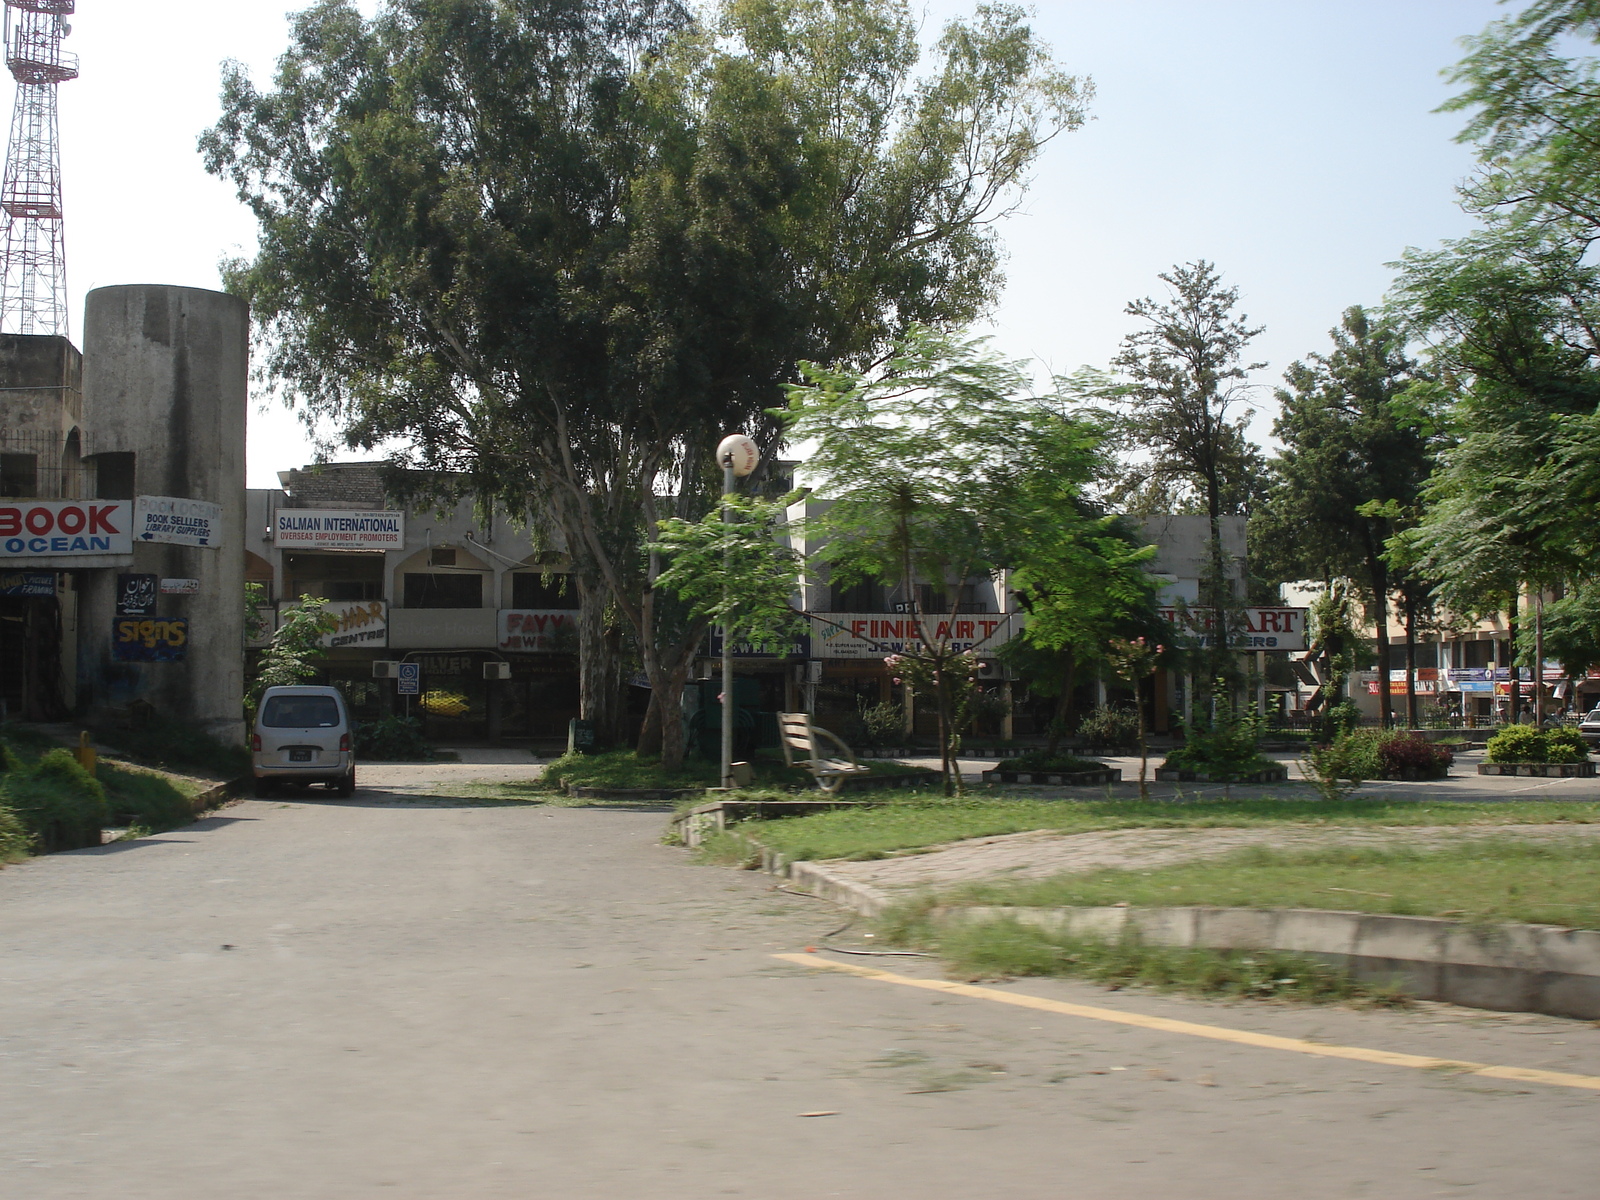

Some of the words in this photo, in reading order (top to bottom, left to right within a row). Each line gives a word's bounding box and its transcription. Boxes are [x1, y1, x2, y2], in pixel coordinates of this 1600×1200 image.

[0, 505, 120, 536] BOOK
[147, 513, 168, 524] BOOK
[279, 516, 321, 530] SALMAN
[324, 517, 400, 532] INTERNATIONAL
[145, 523, 176, 534] LIBRARY
[176, 526, 211, 538] SUPPLIERS
[281, 532, 313, 540] OVERSEAS
[315, 532, 357, 541] EMPLOYMENT
[360, 533, 398, 542] PROMOTERS
[5, 536, 110, 553] OCEAN
[21, 584, 54, 595] FRAMING
[852, 620, 922, 639] FINE
[935, 620, 998, 639] ART
[331, 628, 385, 647] CENTRE
[414, 656, 473, 670] SILVER
